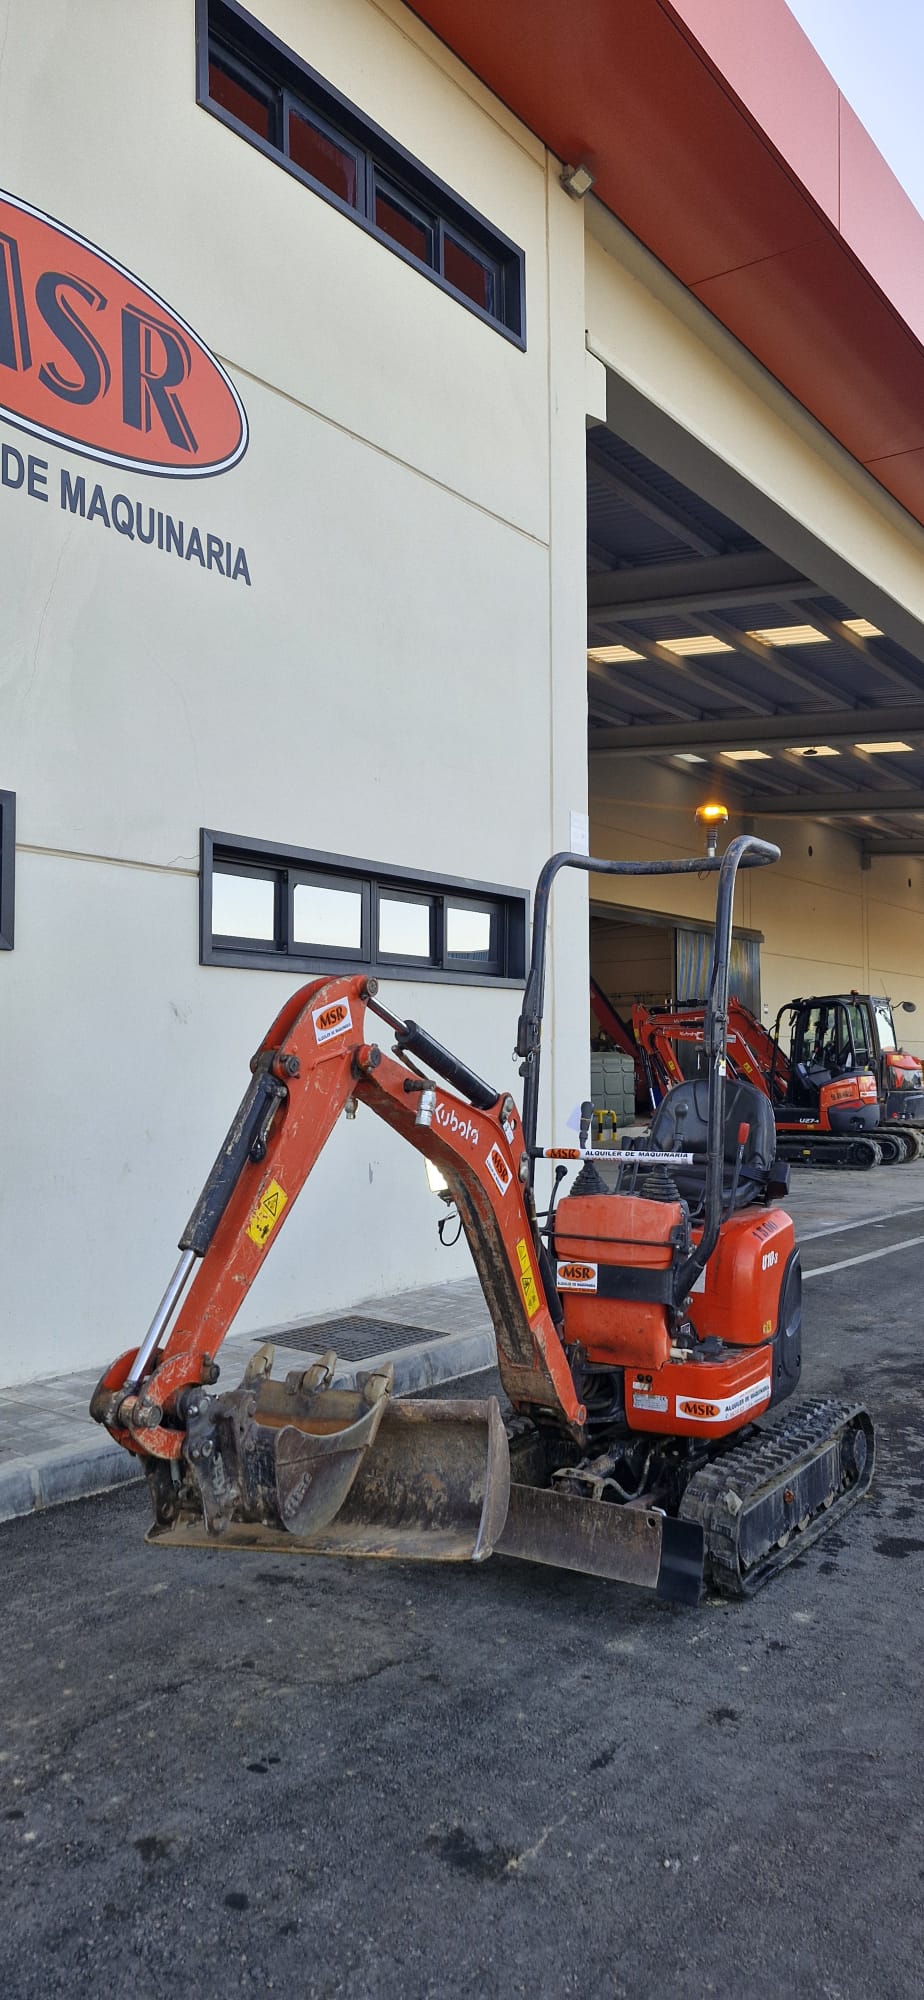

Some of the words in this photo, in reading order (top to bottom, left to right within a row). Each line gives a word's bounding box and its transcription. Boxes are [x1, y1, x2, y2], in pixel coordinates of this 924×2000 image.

[1, 443, 49, 503] DE
[60, 469, 252, 586] MAQUINARIA
[319, 1006, 345, 1030] MSR
[434, 1102, 479, 1145] Kubota
[550, 1148, 576, 1159] MSR
[491, 1151, 508, 1183] MSR
[563, 1265, 590, 1279] MSR
[684, 1402, 715, 1416] MSR
